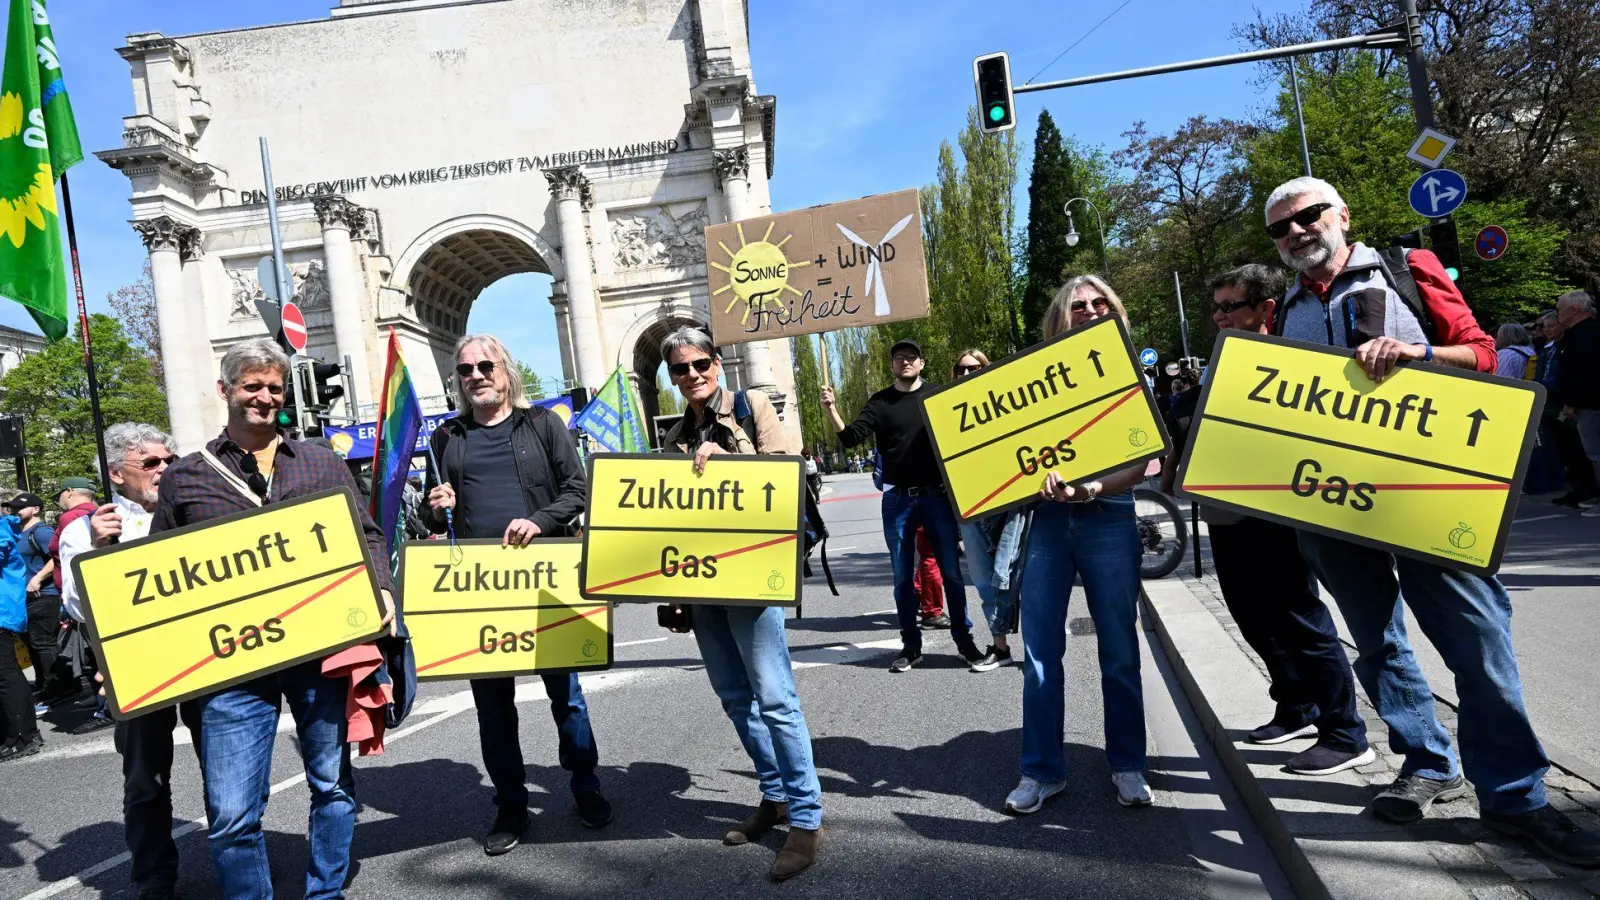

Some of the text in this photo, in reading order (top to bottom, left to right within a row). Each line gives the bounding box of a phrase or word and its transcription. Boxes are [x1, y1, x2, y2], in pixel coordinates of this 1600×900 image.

[275, 185, 304, 201] SIEG
[306, 177, 367, 197] GEWEIHT
[370, 172, 406, 189] VOM
[409, 167, 448, 185] KRIEG
[552, 148, 605, 168] FRIEDEN
[608, 139, 678, 159] MAHNEND
[735, 261, 786, 284] SONNE
[745, 286, 861, 333] Freiheit
[952, 361, 1078, 433] Zukunft
[1247, 365, 1439, 438] Zukunft
[1015, 438, 1077, 477] Gas
[618, 478, 744, 512] Zukunft
[1291, 458, 1377, 512] Gas
[124, 531, 296, 606] Zukunft
[433, 561, 558, 593] Zukunft
[660, 545, 718, 579] Gas
[208, 617, 286, 659] Gas
[479, 624, 535, 655] Gas
